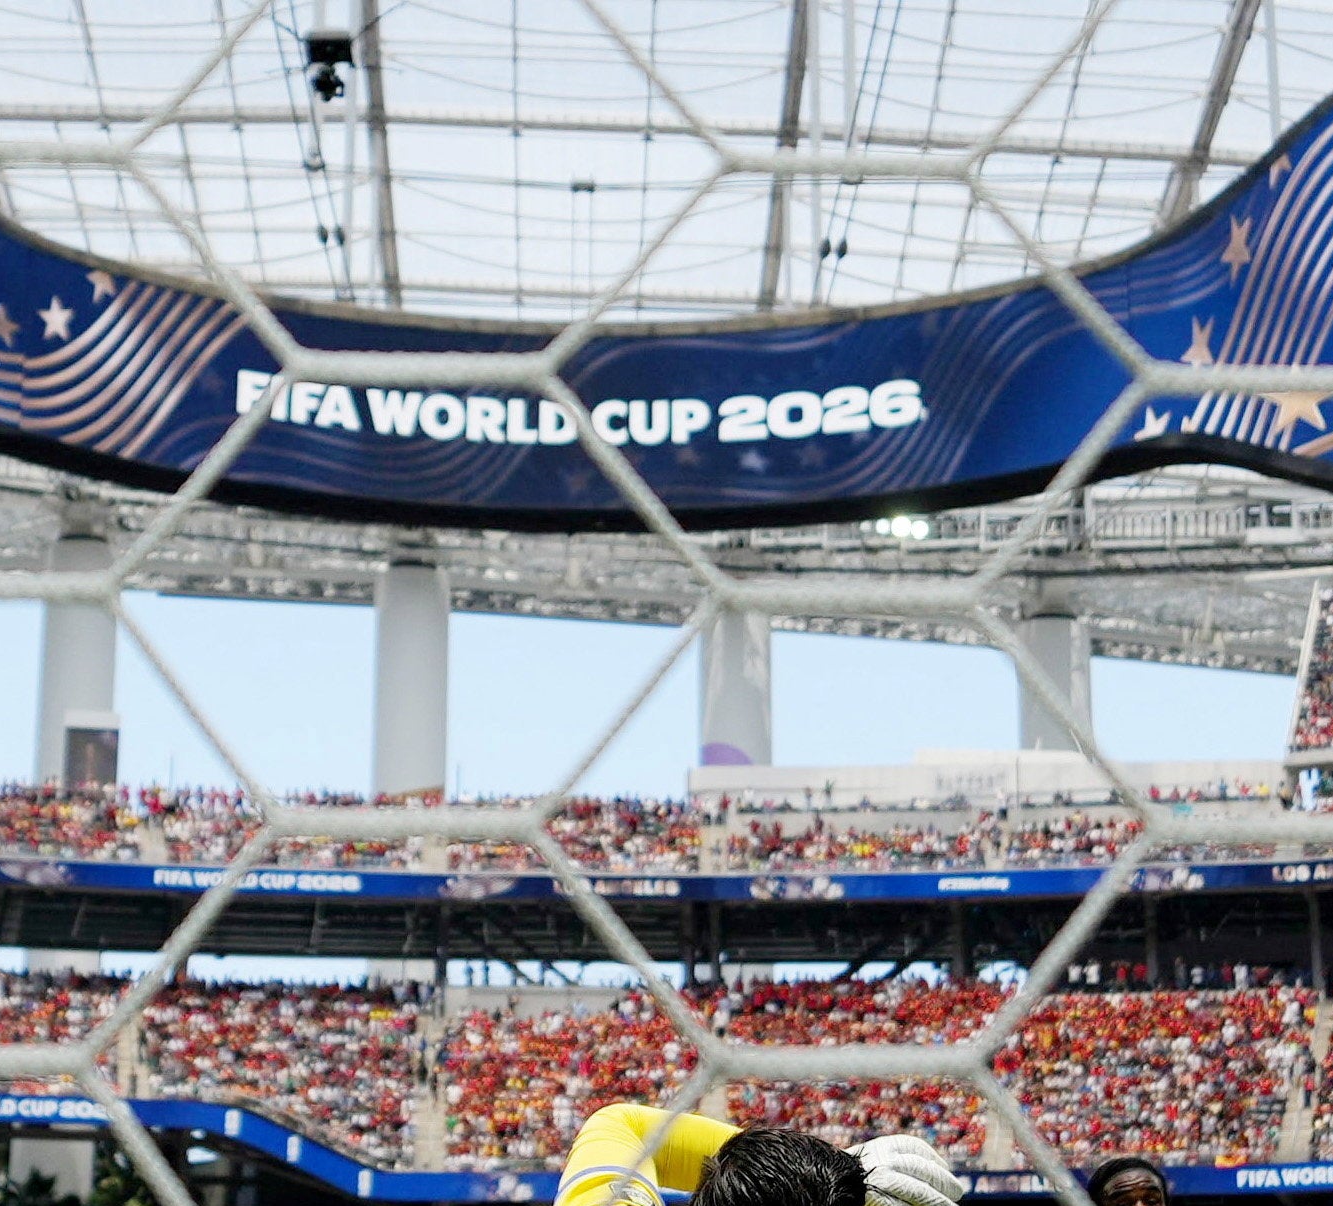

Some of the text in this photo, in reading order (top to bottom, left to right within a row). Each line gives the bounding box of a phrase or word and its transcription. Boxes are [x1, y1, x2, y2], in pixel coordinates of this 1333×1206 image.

[236, 368, 922, 446] FIFA WORLD CUP 2026
[18, 1099, 59, 1117] CUP
[1236, 1168, 1281, 1188] FIFA
